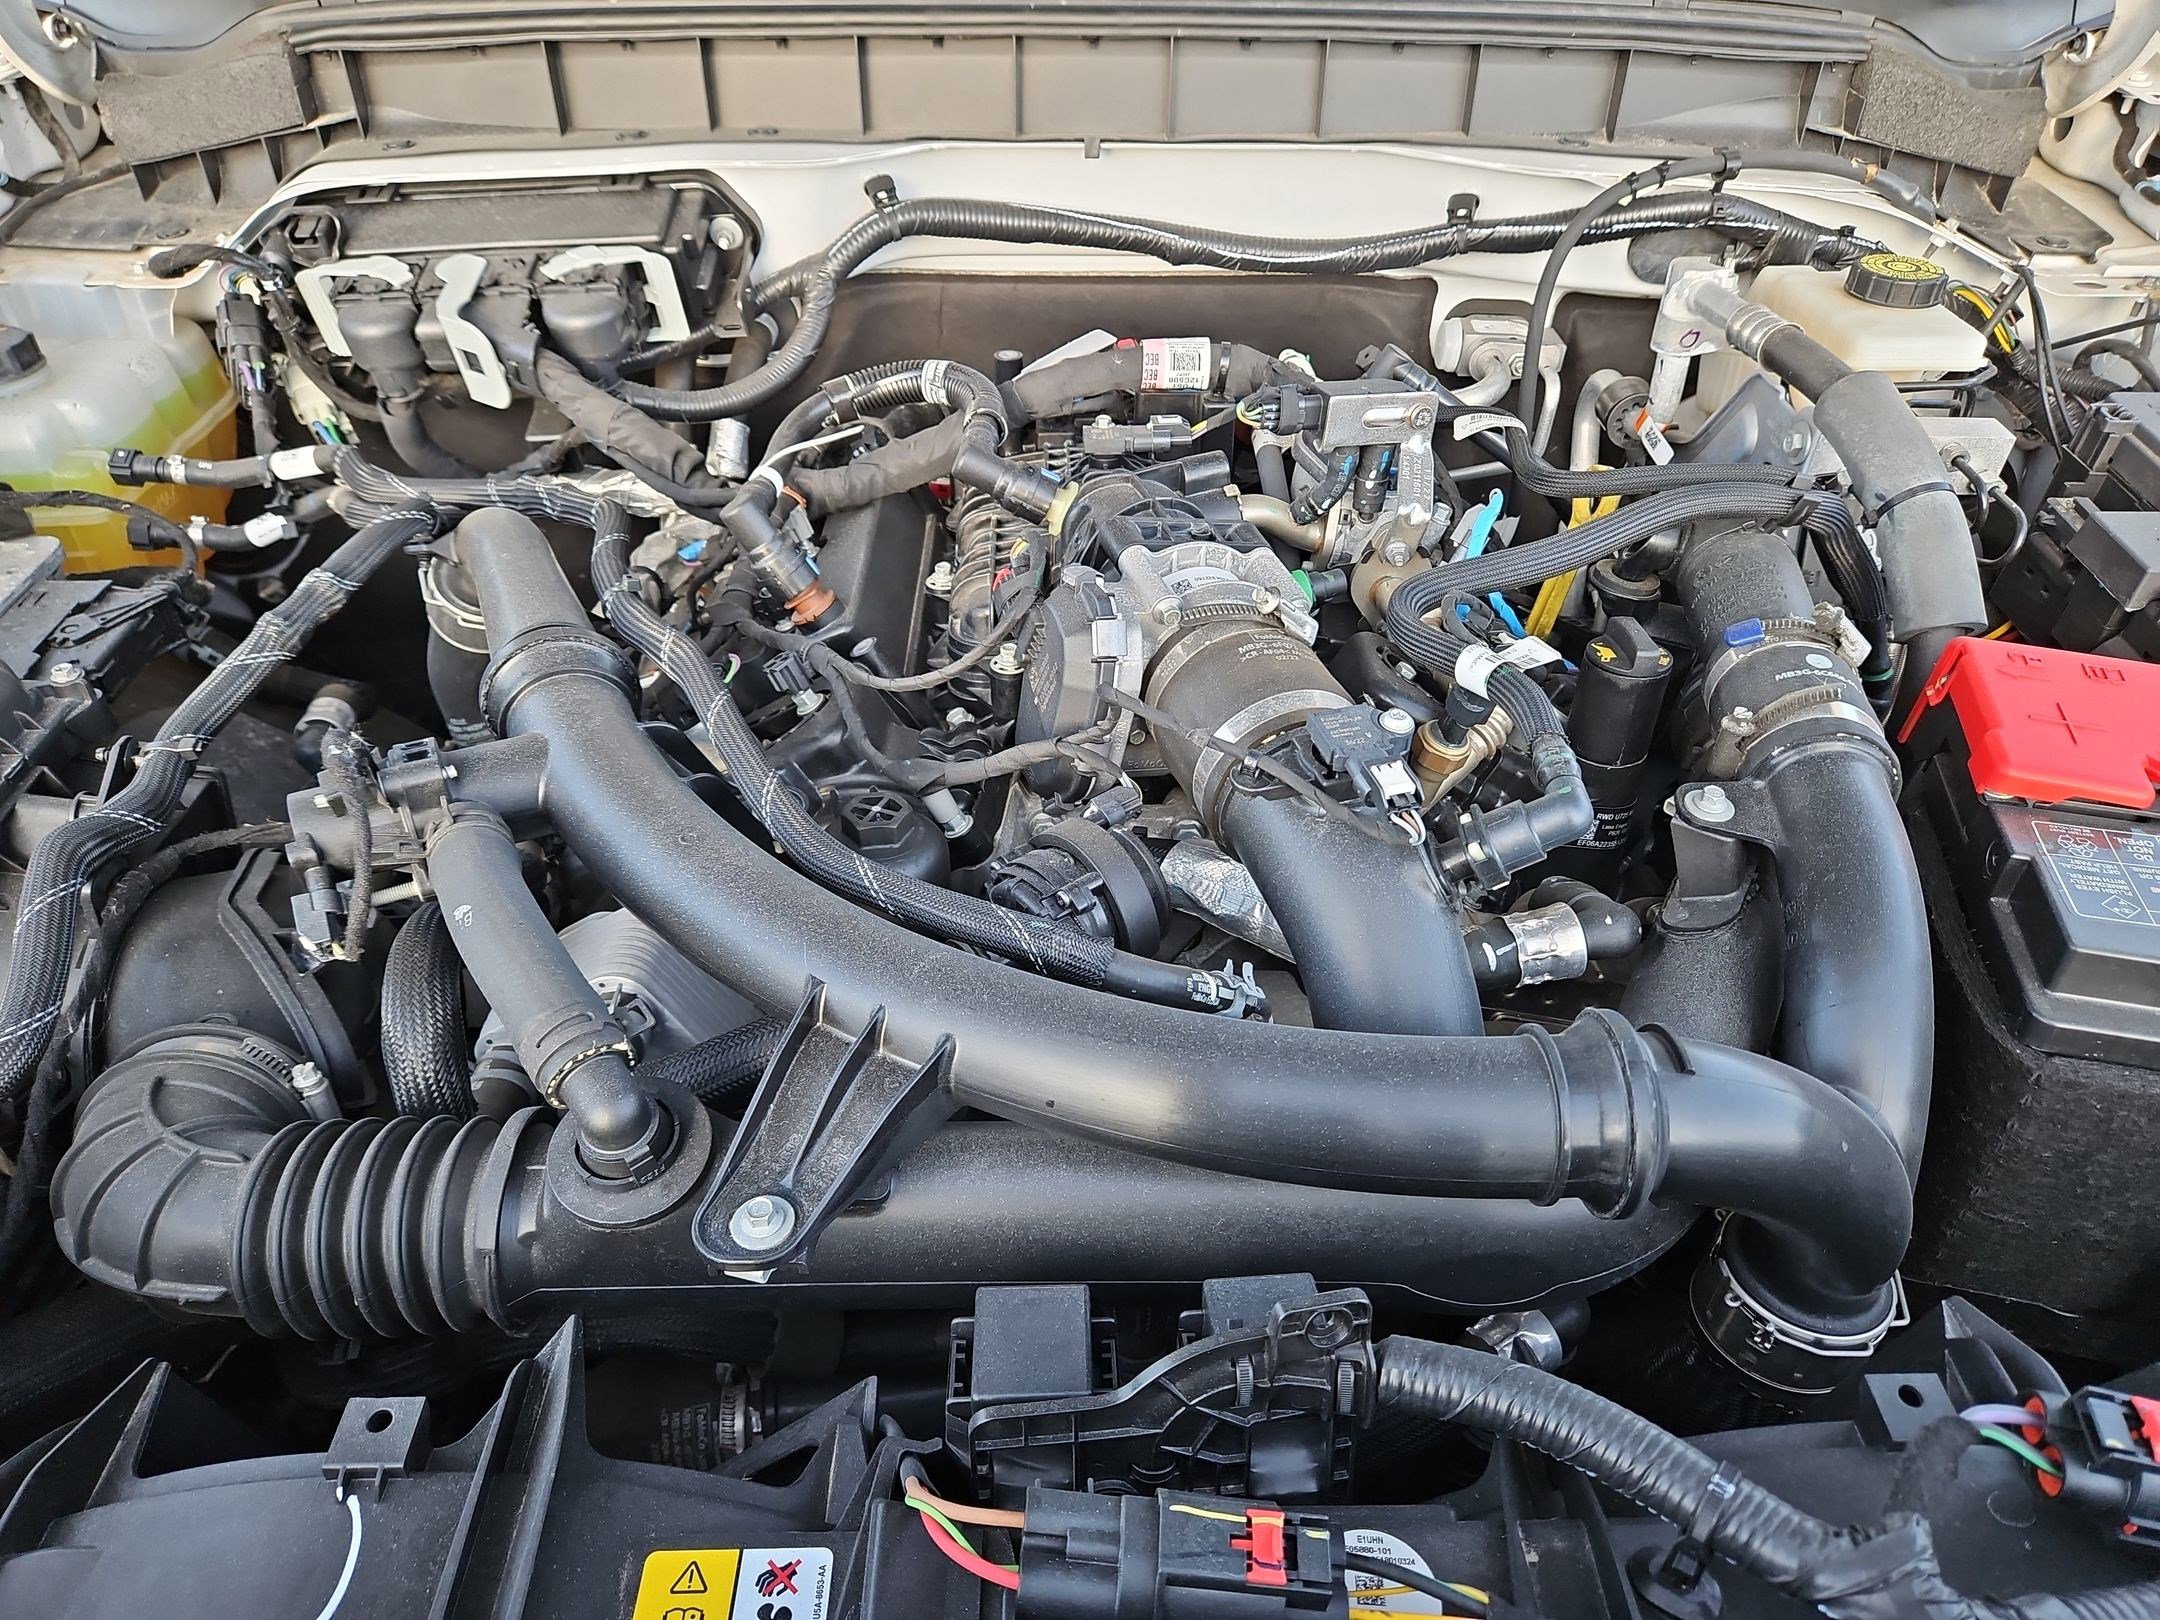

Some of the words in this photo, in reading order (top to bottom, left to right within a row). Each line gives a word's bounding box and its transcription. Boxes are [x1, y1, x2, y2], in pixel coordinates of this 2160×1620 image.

[1145, 353, 1159, 366] BEC
[1144, 369, 1158, 381] BEC
[2113, 836, 2155, 847] OPEN.
[2126, 845, 2154, 855] NOT
[2133, 853, 2154, 862] DO
[1356, 1535, 1384, 1544] E1UHN
[812, 1564, 827, 1620] U5A-8653-AA
